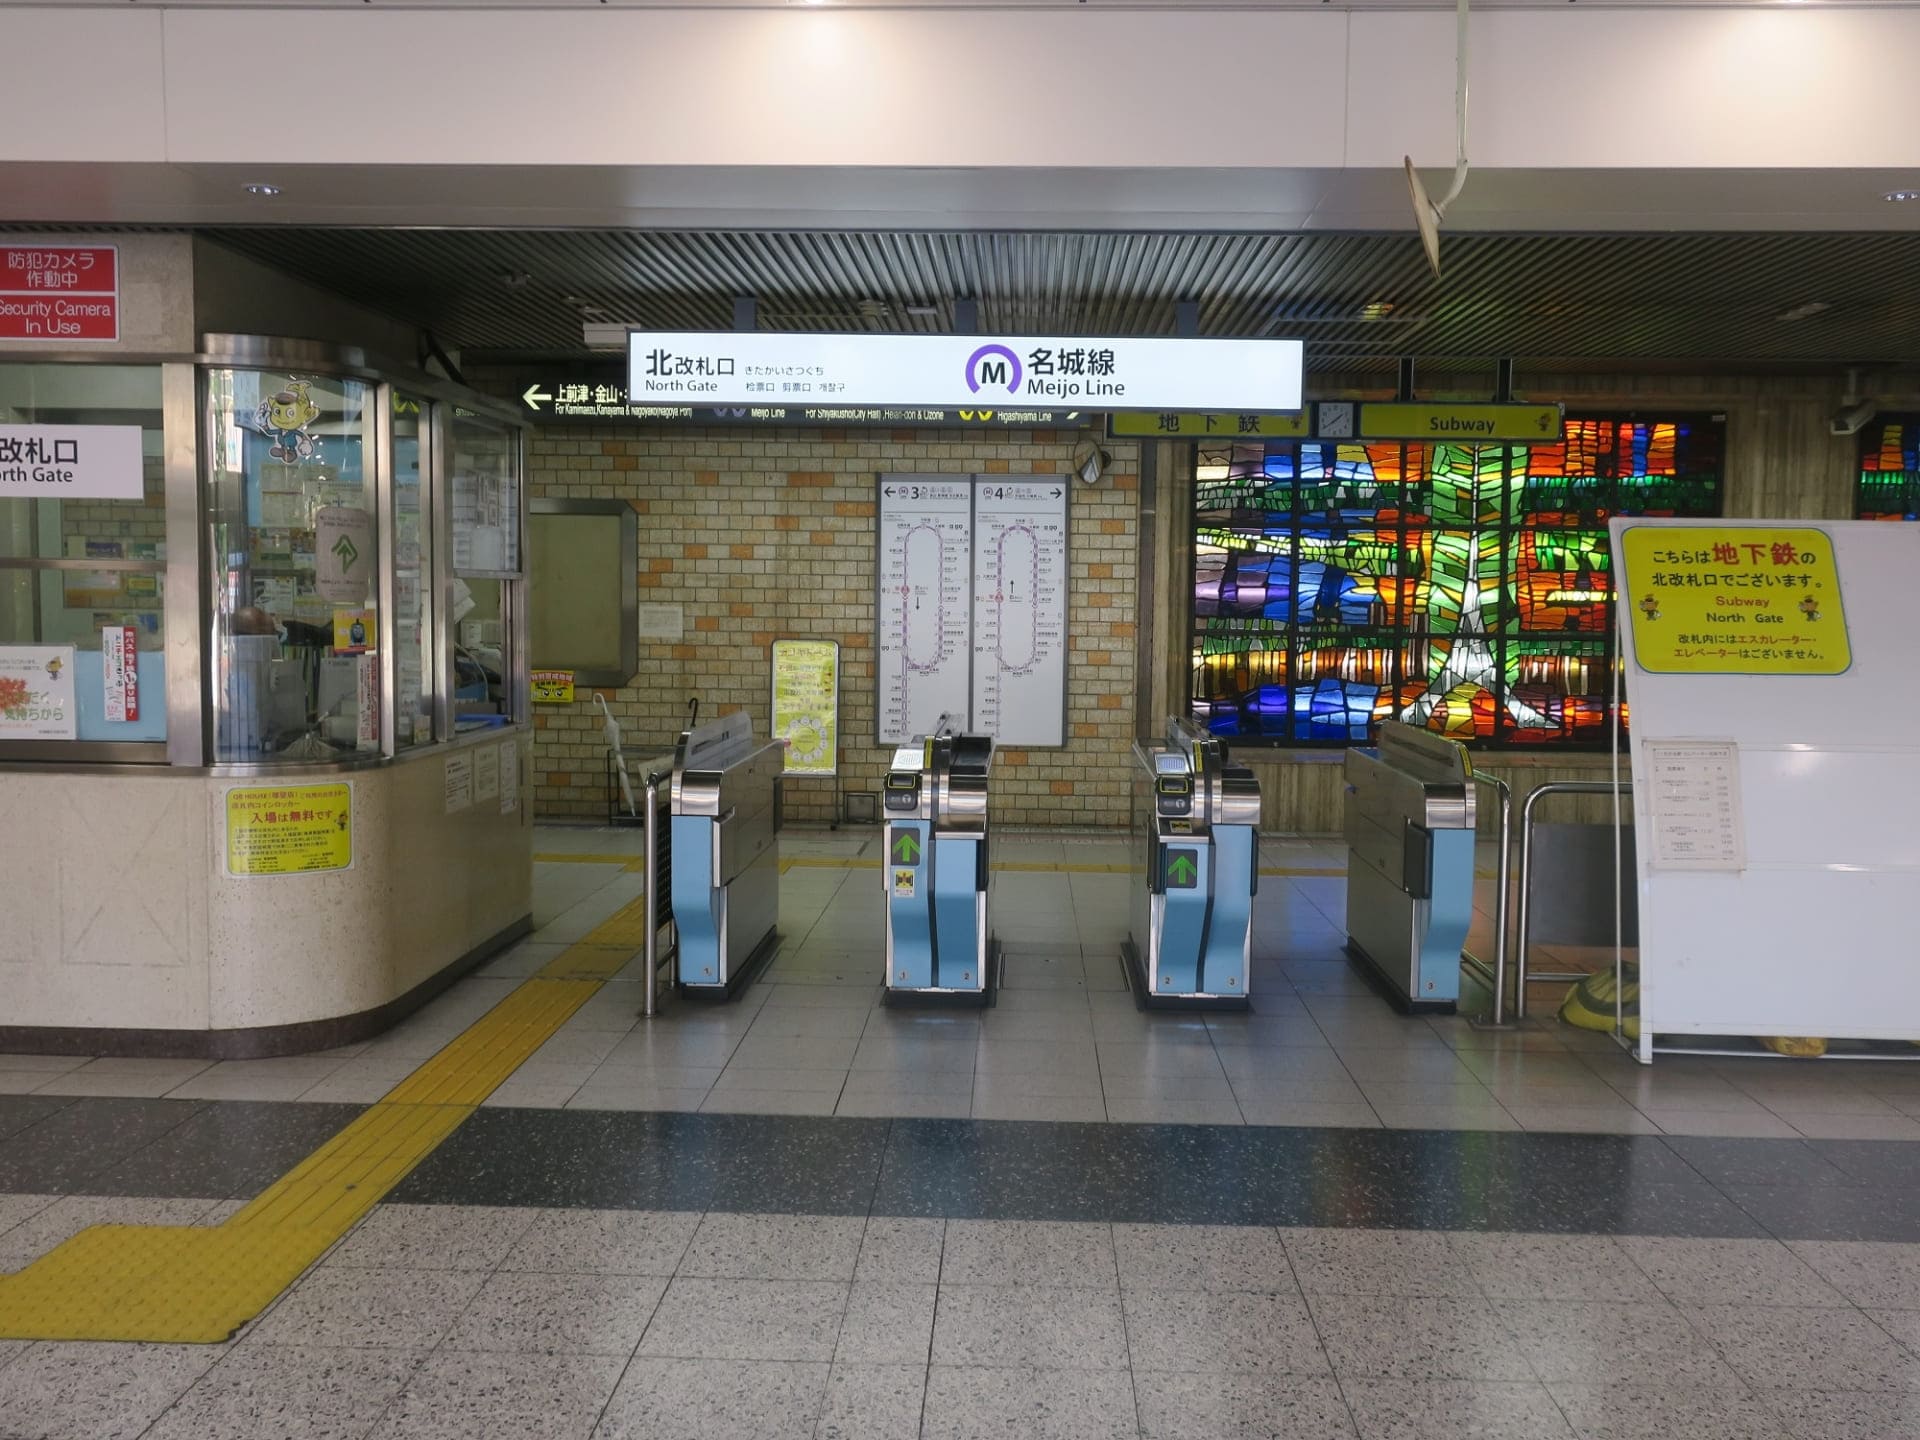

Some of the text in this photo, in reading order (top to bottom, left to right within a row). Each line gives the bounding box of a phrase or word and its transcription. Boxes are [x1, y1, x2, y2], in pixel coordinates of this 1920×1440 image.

[8, 252, 95, 270] 防犯カメラ
[26, 270, 78, 288] 作動中
[55, 300, 111, 316] Camera
[26, 318, 80, 334] In Use
[646, 348, 734, 376] 北改札口
[1028, 348, 1115, 376] 名城線
[555, 384, 628, 403] 上前津・金山・
[646, 380, 718, 392] North Gate
[1028, 378, 1125, 399] Meijo Line
[556, 404, 564, 414] For
[752, 408, 786, 420] Meijo Line
[1038, 412, 1052, 422] Line
[1158, 413, 1260, 432] 地下鉄
[1430, 416, 1496, 434] Subway
[0, 437, 78, 464] 改札口
[0, 466, 73, 482] rth Gate
[911, 486, 920, 500] 3
[994, 487, 1003, 500] 4
[1653, 542, 1816, 566] こちらは地下鉄の
[1652, 572, 1822, 588] 北改札口でございます。
[1716, 595, 1770, 608] Subway
[1706, 612, 1784, 624] North Gate
[251, 810, 333, 824] 入場は無料です
